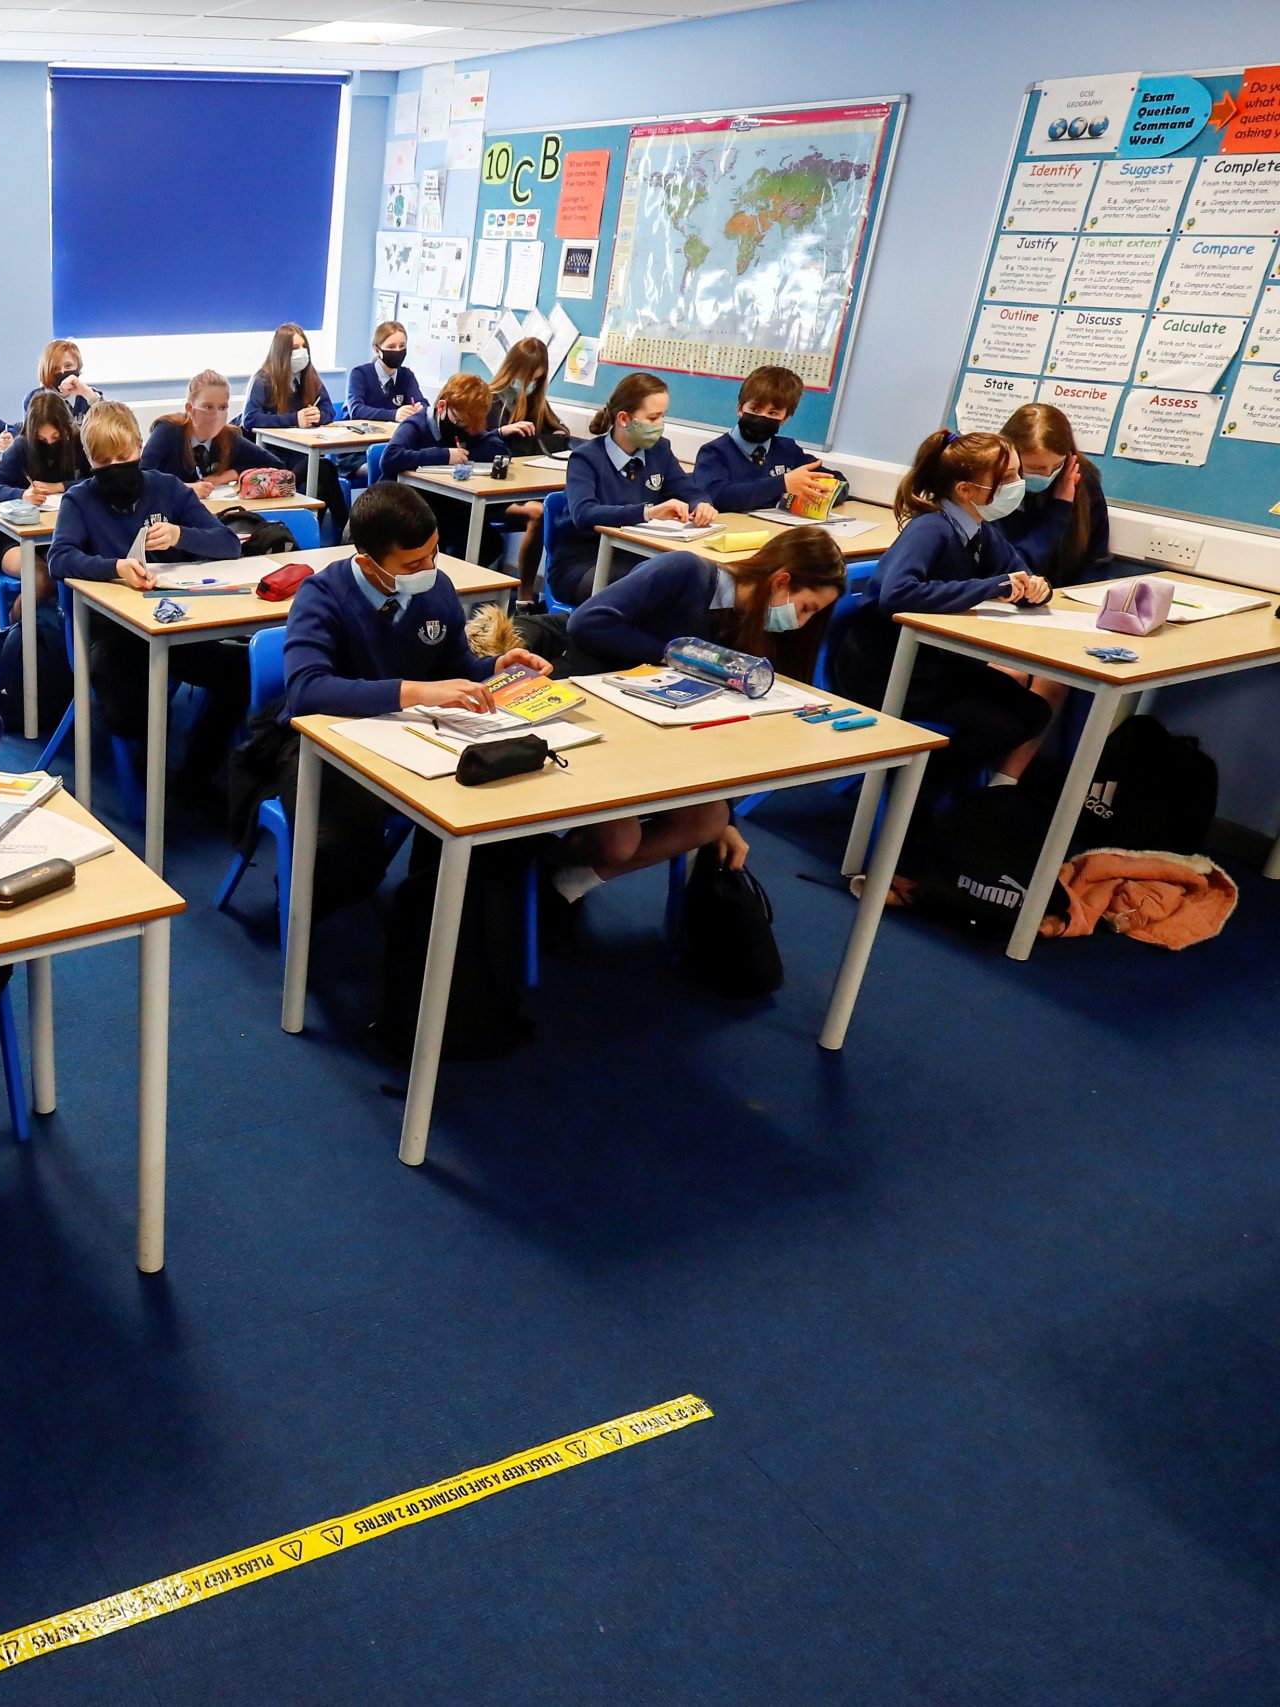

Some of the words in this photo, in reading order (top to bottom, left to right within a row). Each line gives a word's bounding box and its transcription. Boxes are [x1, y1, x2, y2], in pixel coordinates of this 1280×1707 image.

[1250, 82, 1267, 93] Do
[1067, 100, 1104, 108] GEOGRAPHY
[1246, 97, 1276, 108] what
[1138, 105, 1190, 118] Question
[1133, 118, 1195, 131] Command
[1235, 128, 1272, 139] asking
[486, 148, 509, 179] 10
[1120, 163, 1173, 178] Suggest
[1215, 159, 1280, 176] Complete
[1030, 164, 1082, 179] Identify
[1017, 237, 1058, 253] Justify
[1084, 238, 1095, 247] To
[1099, 238, 1123, 247] what
[1127, 239, 1162, 247] extent
[1193, 241, 1255, 258] Compare
[1000, 309, 1039, 321] Outline
[1077, 313, 1123, 326] Discuss
[1163, 319, 1227, 334] Calculate
[984, 378, 1014, 390] State
[1055, 385, 1108, 400] Describe
[1150, 395, 1198, 408] Assess
[1084, 796, 1114, 819] das
[957, 874, 1020, 909] PUMA
[524, 1451, 563, 1472] PLEASE
[491, 1473, 501, 1484] A
[502, 1464, 528, 1482] KEEP
[466, 1476, 494, 1493] SAFE
[418, 1484, 469, 1511] DISTANCE
[395, 1507, 406, 1519] 2
[405, 1503, 420, 1516] OF
[354, 1510, 398, 1534] METRES
[234, 1553, 275, 1578] PLEASE
[192, 1579, 202, 1592] A
[205, 1568, 233, 1589] KEEP
